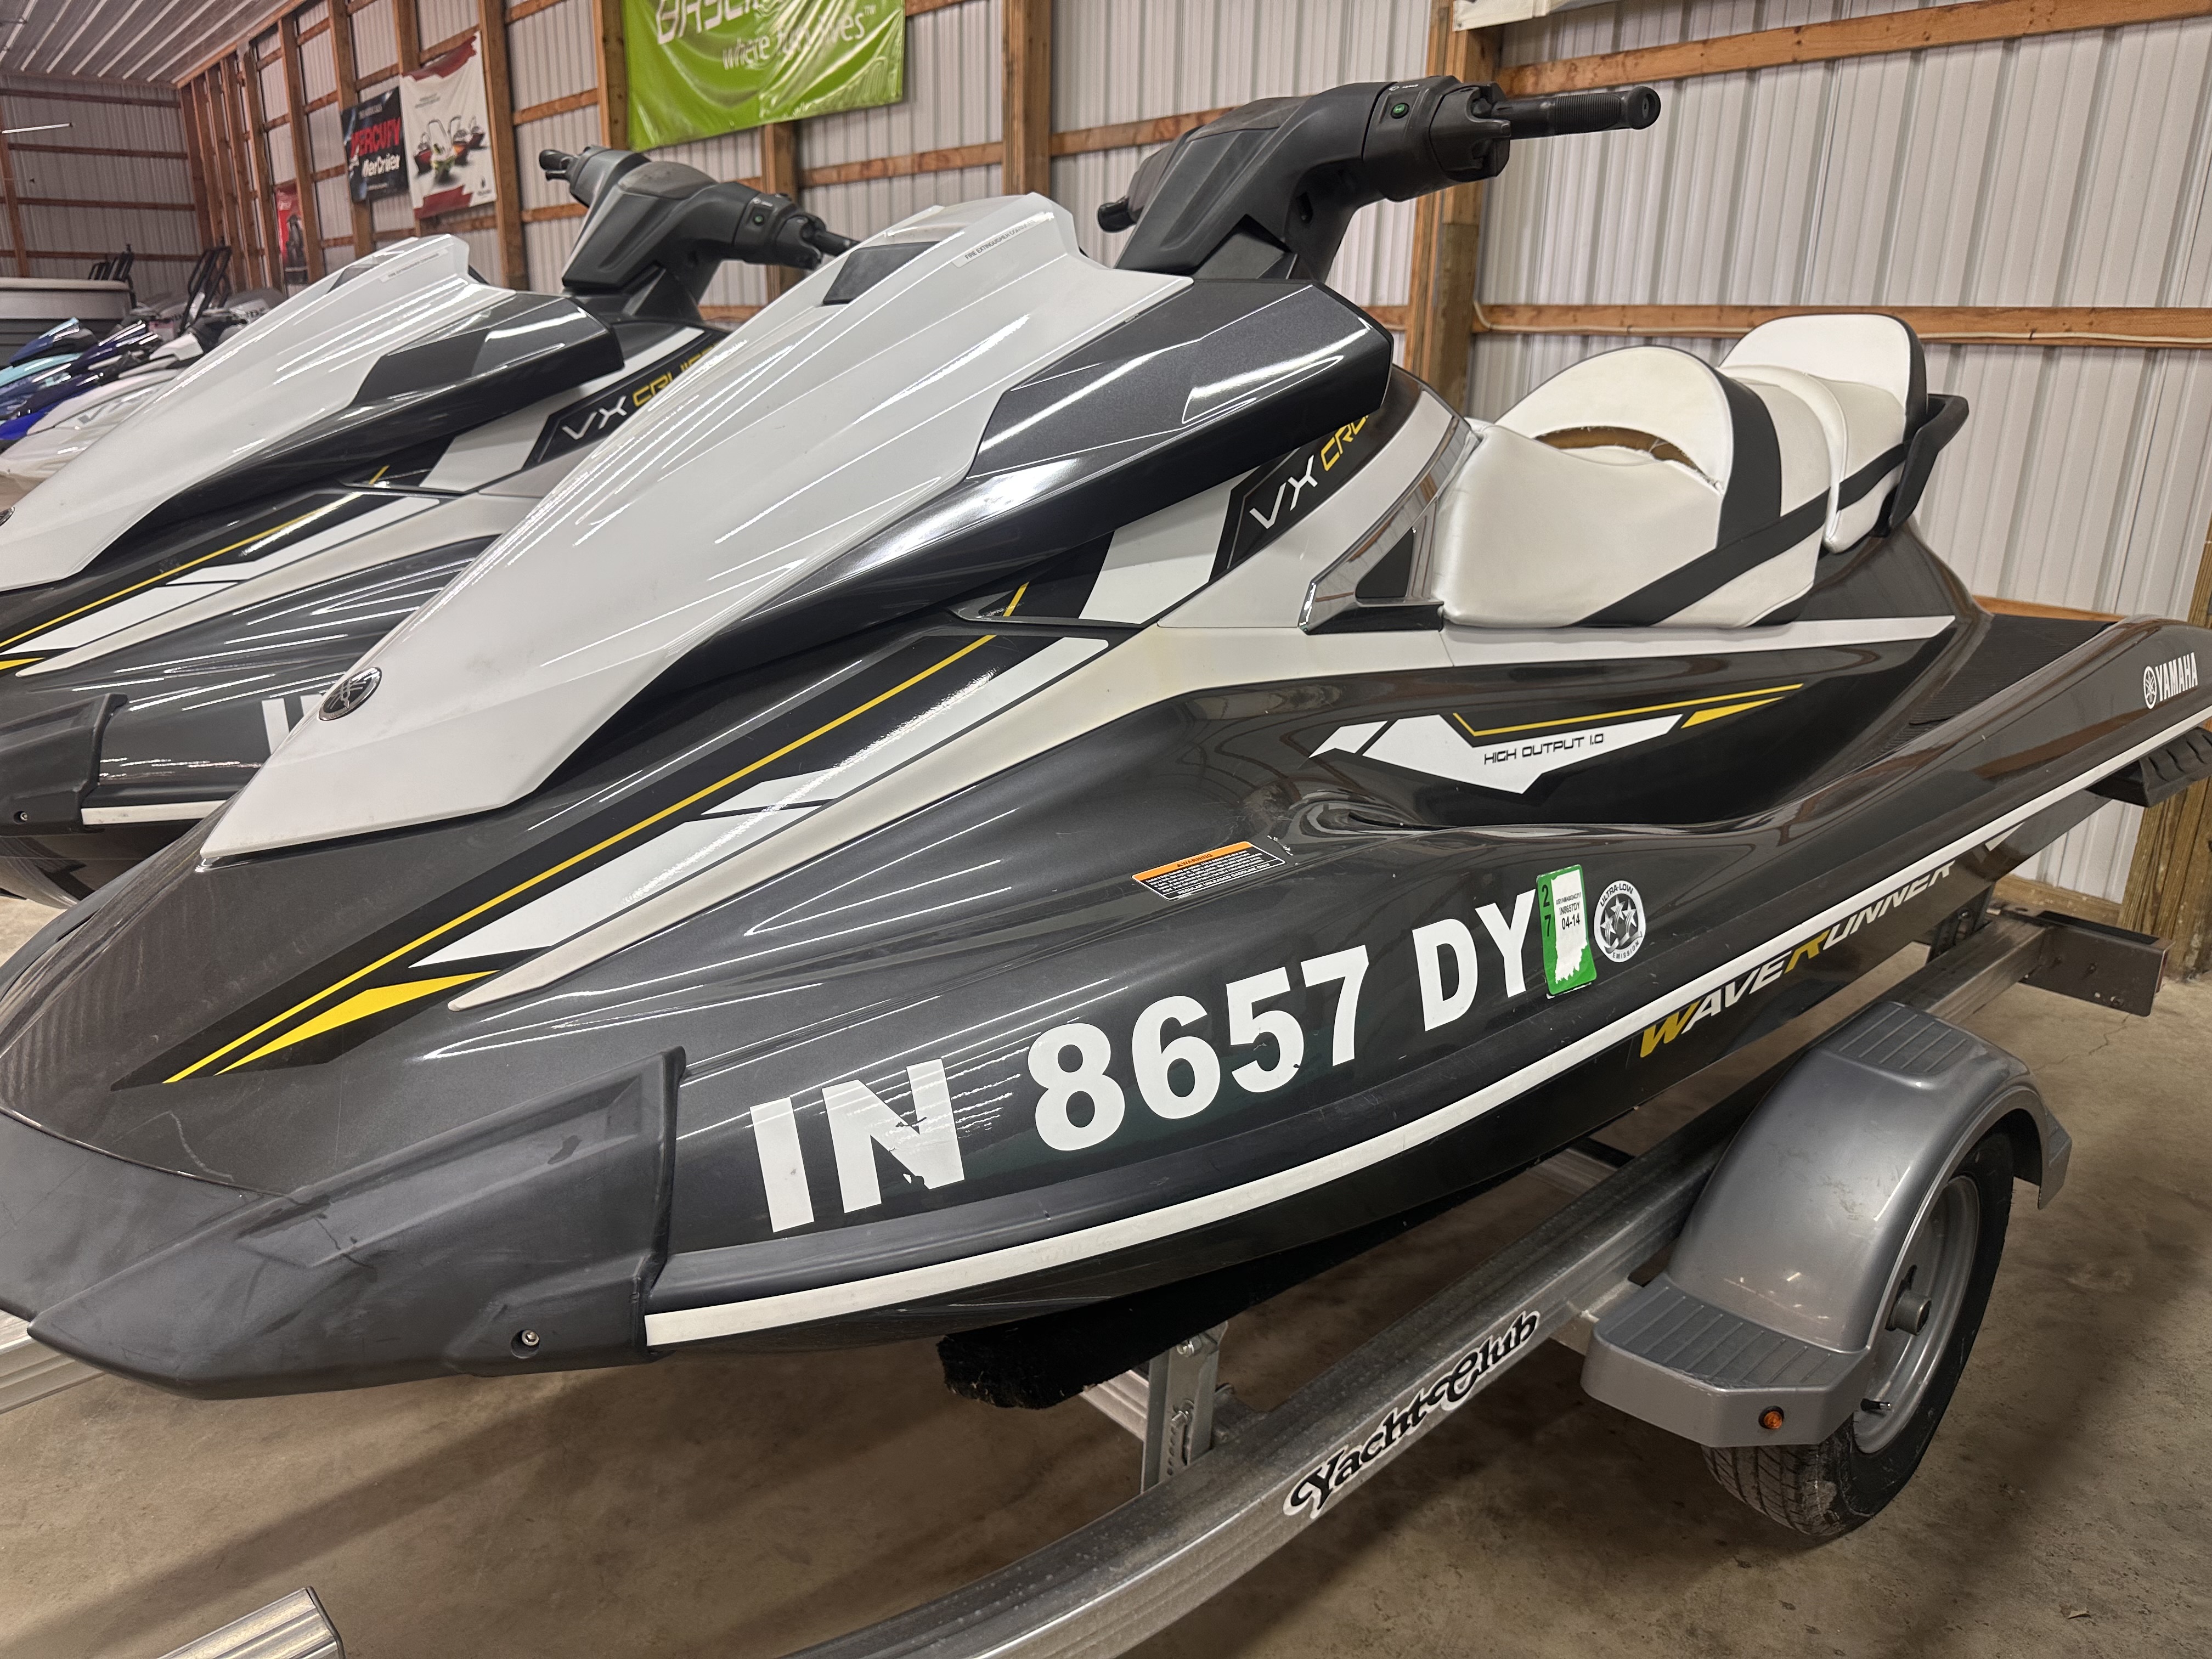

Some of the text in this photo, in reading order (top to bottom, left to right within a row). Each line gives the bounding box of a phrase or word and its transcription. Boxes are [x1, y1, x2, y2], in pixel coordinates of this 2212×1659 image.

[964, 250, 977, 260] FIRE
[551, 395, 627, 440] VX
[1249, 454, 1318, 529] VX
[2155, 652, 2198, 702] YAMAHA
[1484, 748, 1516, 765] HIGH
[1522, 737, 1584, 758] OUTPUT
[1181, 854, 1214, 865] WARNING
[1177, 883, 1203, 894] REGULAR
[1203, 875, 1231, 886] UNLEADED
[1231, 867, 1257, 878] GASOLINE
[1559, 901, 1580, 915] IN8657DY
[1562, 913, 1580, 930] 04-14
[1612, 940, 1639, 959] EMISSION
[749, 889, 1536, 1232] IN 8657 DY
[1288, 1313, 1538, 1512] Yacht Club
